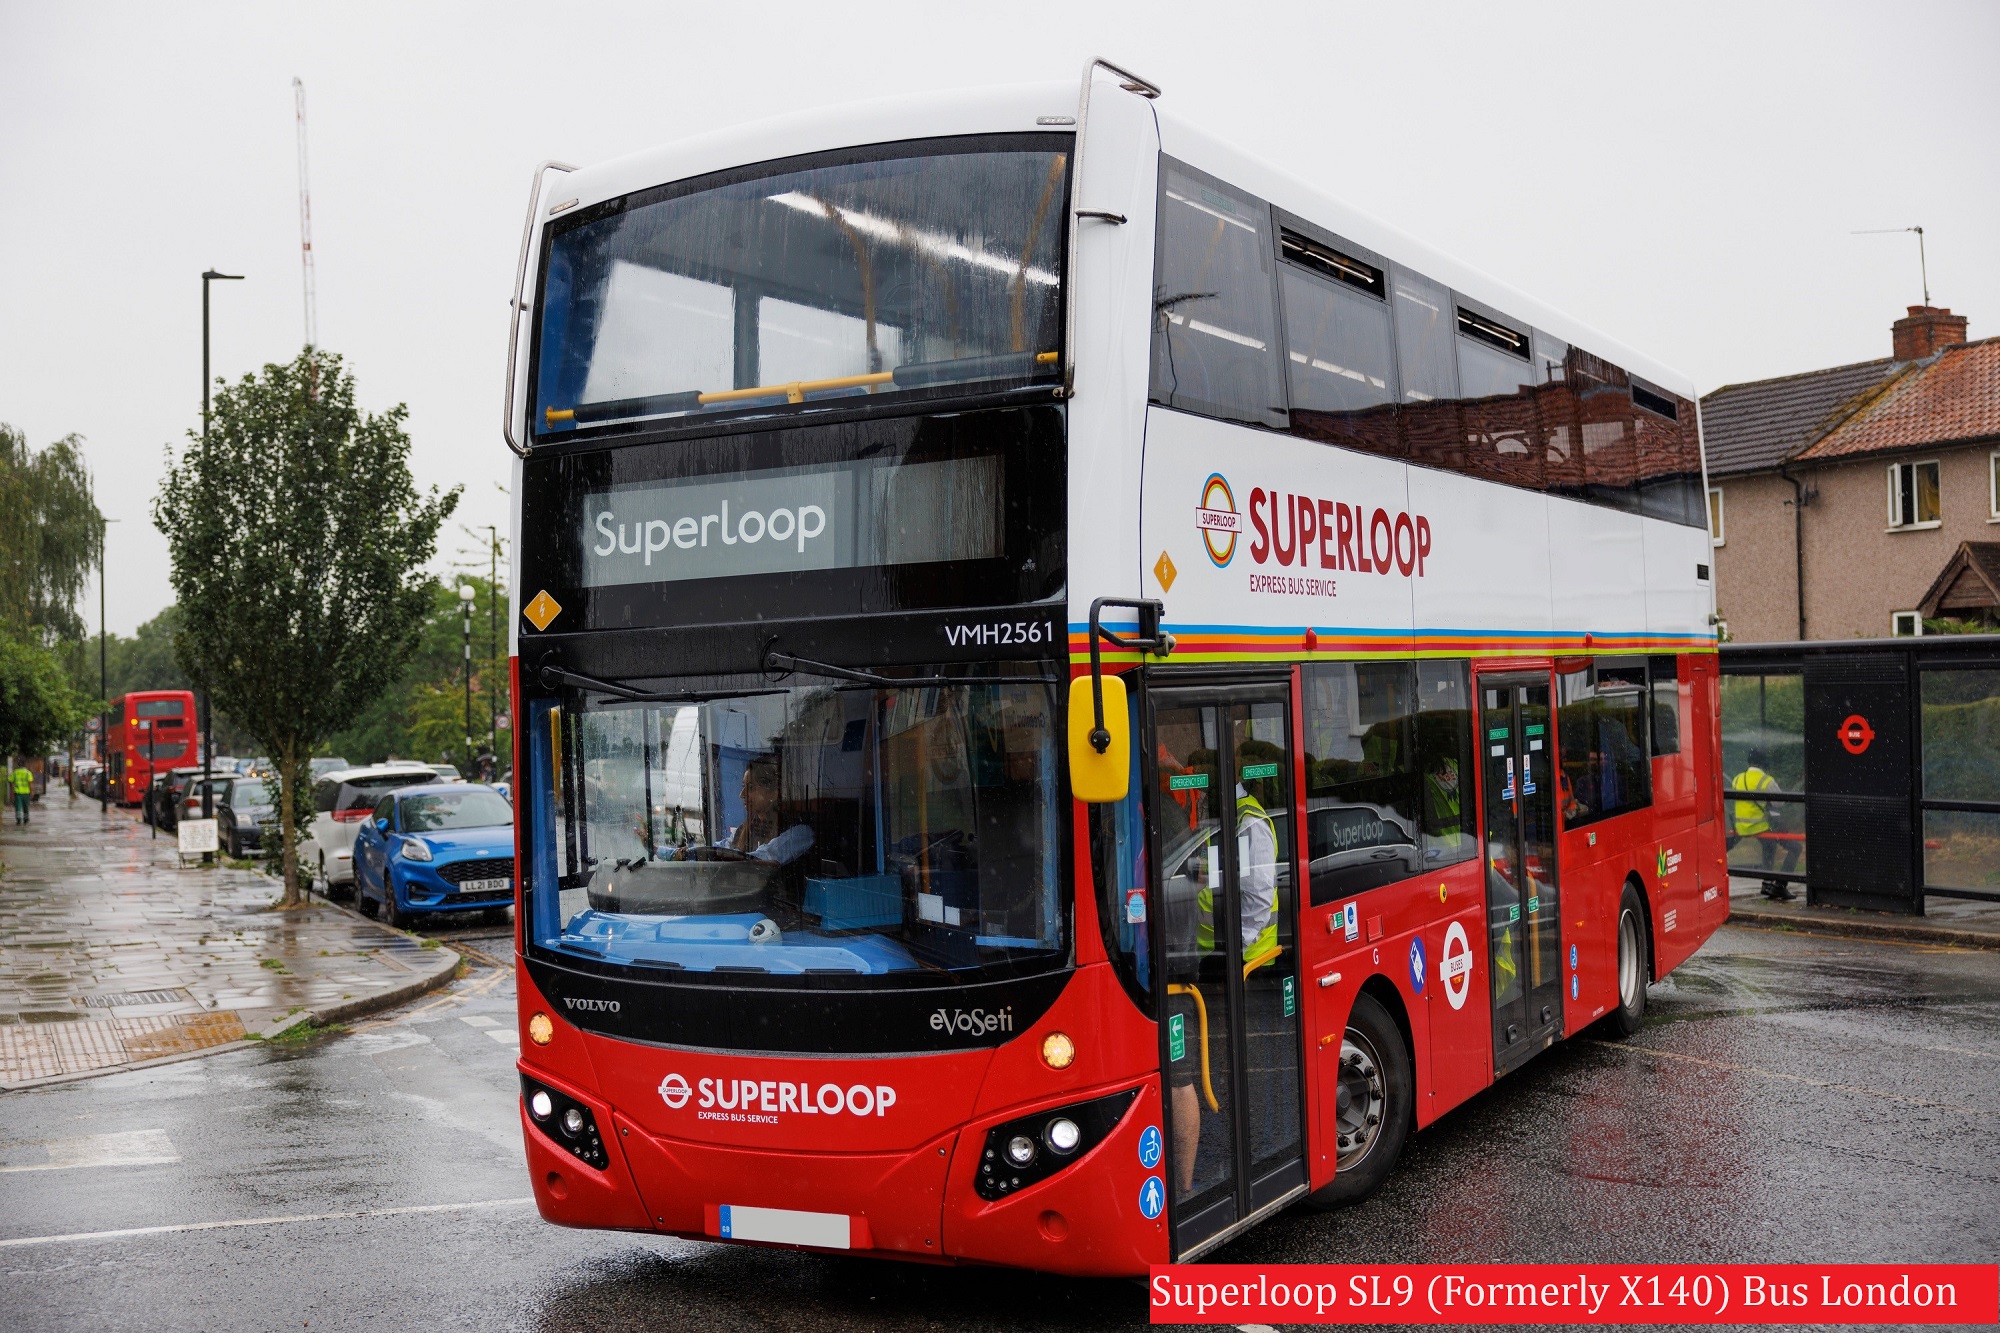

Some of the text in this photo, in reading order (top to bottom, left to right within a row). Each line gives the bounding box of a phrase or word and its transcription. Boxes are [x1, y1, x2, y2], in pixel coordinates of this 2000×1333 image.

[1202, 513, 1236, 528] SUPERLOOP
[593, 500, 826, 566] Superloop
[1250, 487, 1432, 578] SUPERLOOP
[1250, 574, 1337, 597] EXPRESS BUS SERVICE
[944, 620, 1053, 647] VMH2561
[1245, 766, 1275, 777] EMERGENCY EXIT
[1172, 776, 1206, 788] EMERGENCY EXIT
[1333, 817, 1384, 851] Superloop
[465, 881, 485, 891] LL21
[1373, 948, 1379, 965] G
[1450, 958, 1463, 973] BUSES
[563, 997, 621, 1013] VOLVO
[929, 1005, 1013, 1037] eVoSeti
[698, 1077, 897, 1117] SUPERLOOP
[698, 1111, 779, 1124] EXPRESS BUS SERVICE
